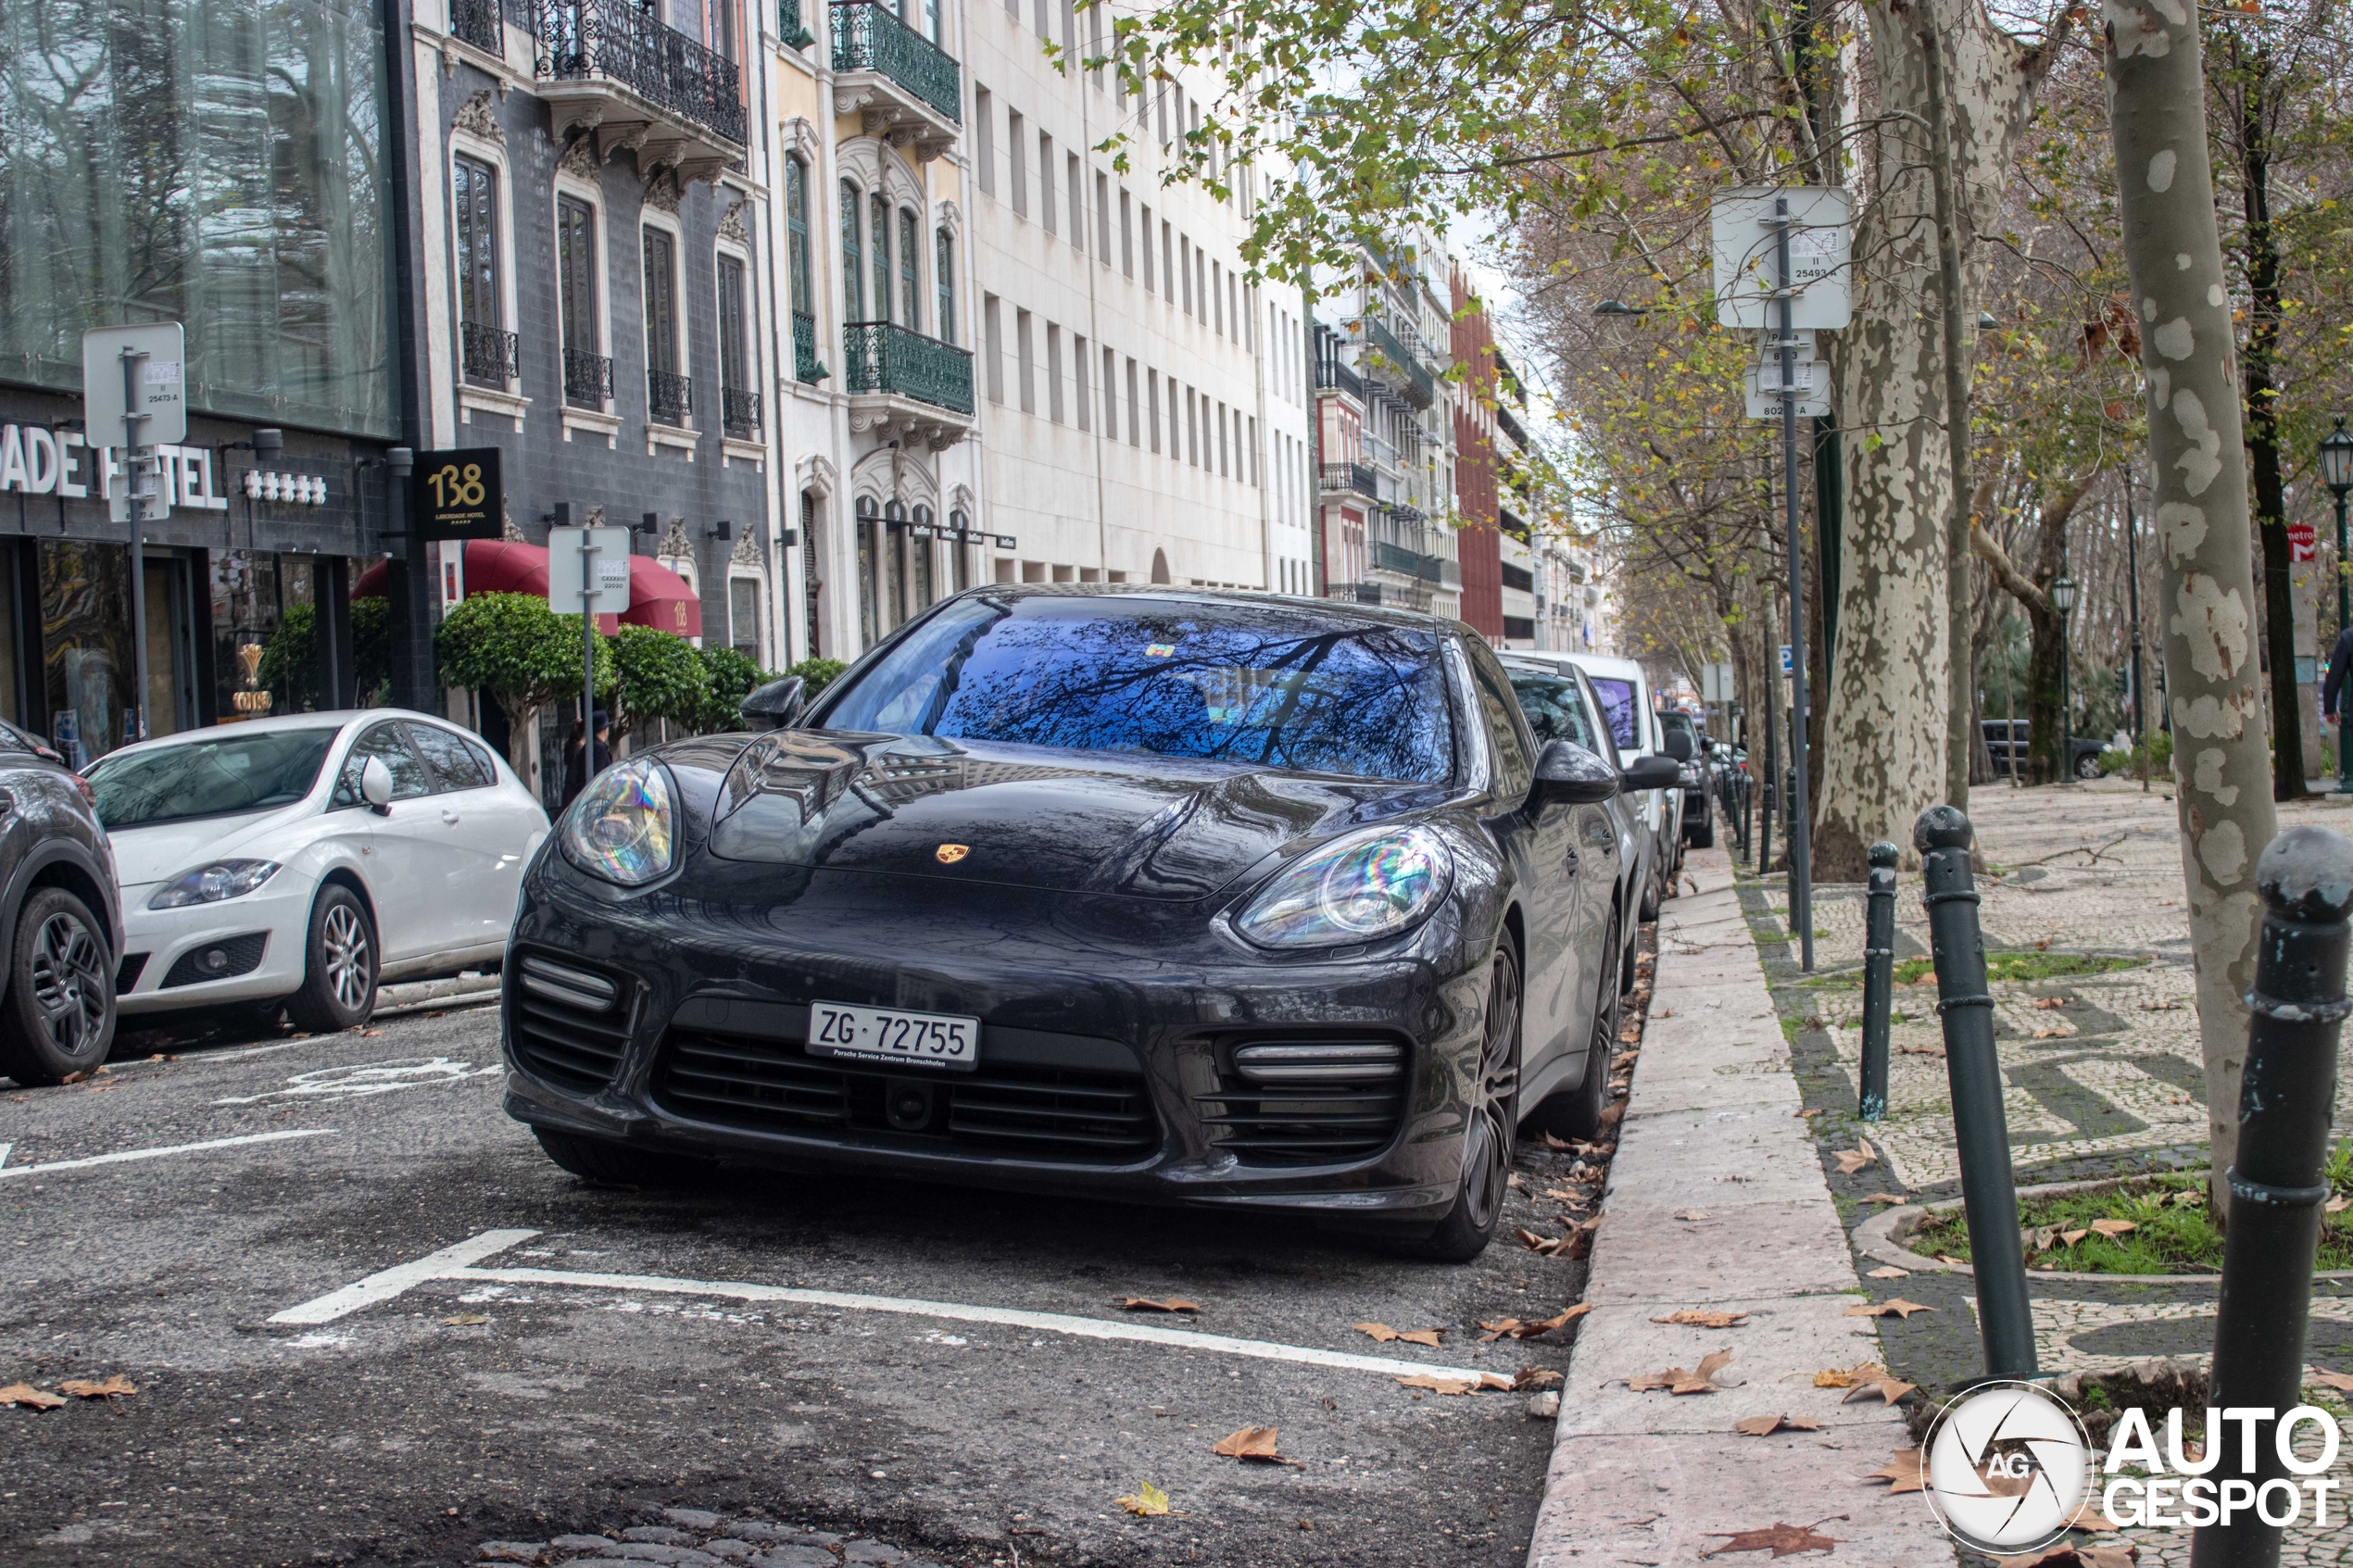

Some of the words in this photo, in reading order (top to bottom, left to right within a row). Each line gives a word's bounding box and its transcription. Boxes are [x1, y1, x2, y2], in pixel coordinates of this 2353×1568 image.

[1795, 269, 1837, 278] 25493A
[148, 394, 178, 403] 25473-A
[0, 424, 87, 498] ADE
[100, 444, 228, 509] HTEL
[427, 463, 485, 508] 138
[2286, 531, 2314, 540] metro
[820, 1010, 855, 1044] ZG
[876, 1015, 965, 1055] 72755
[834, 1048, 857, 1058] Porsche
[858, 1051, 880, 1060] Service
[880, 1054, 905, 1063] Zentrum
[906, 1057, 946, 1067] Bronschhofen
